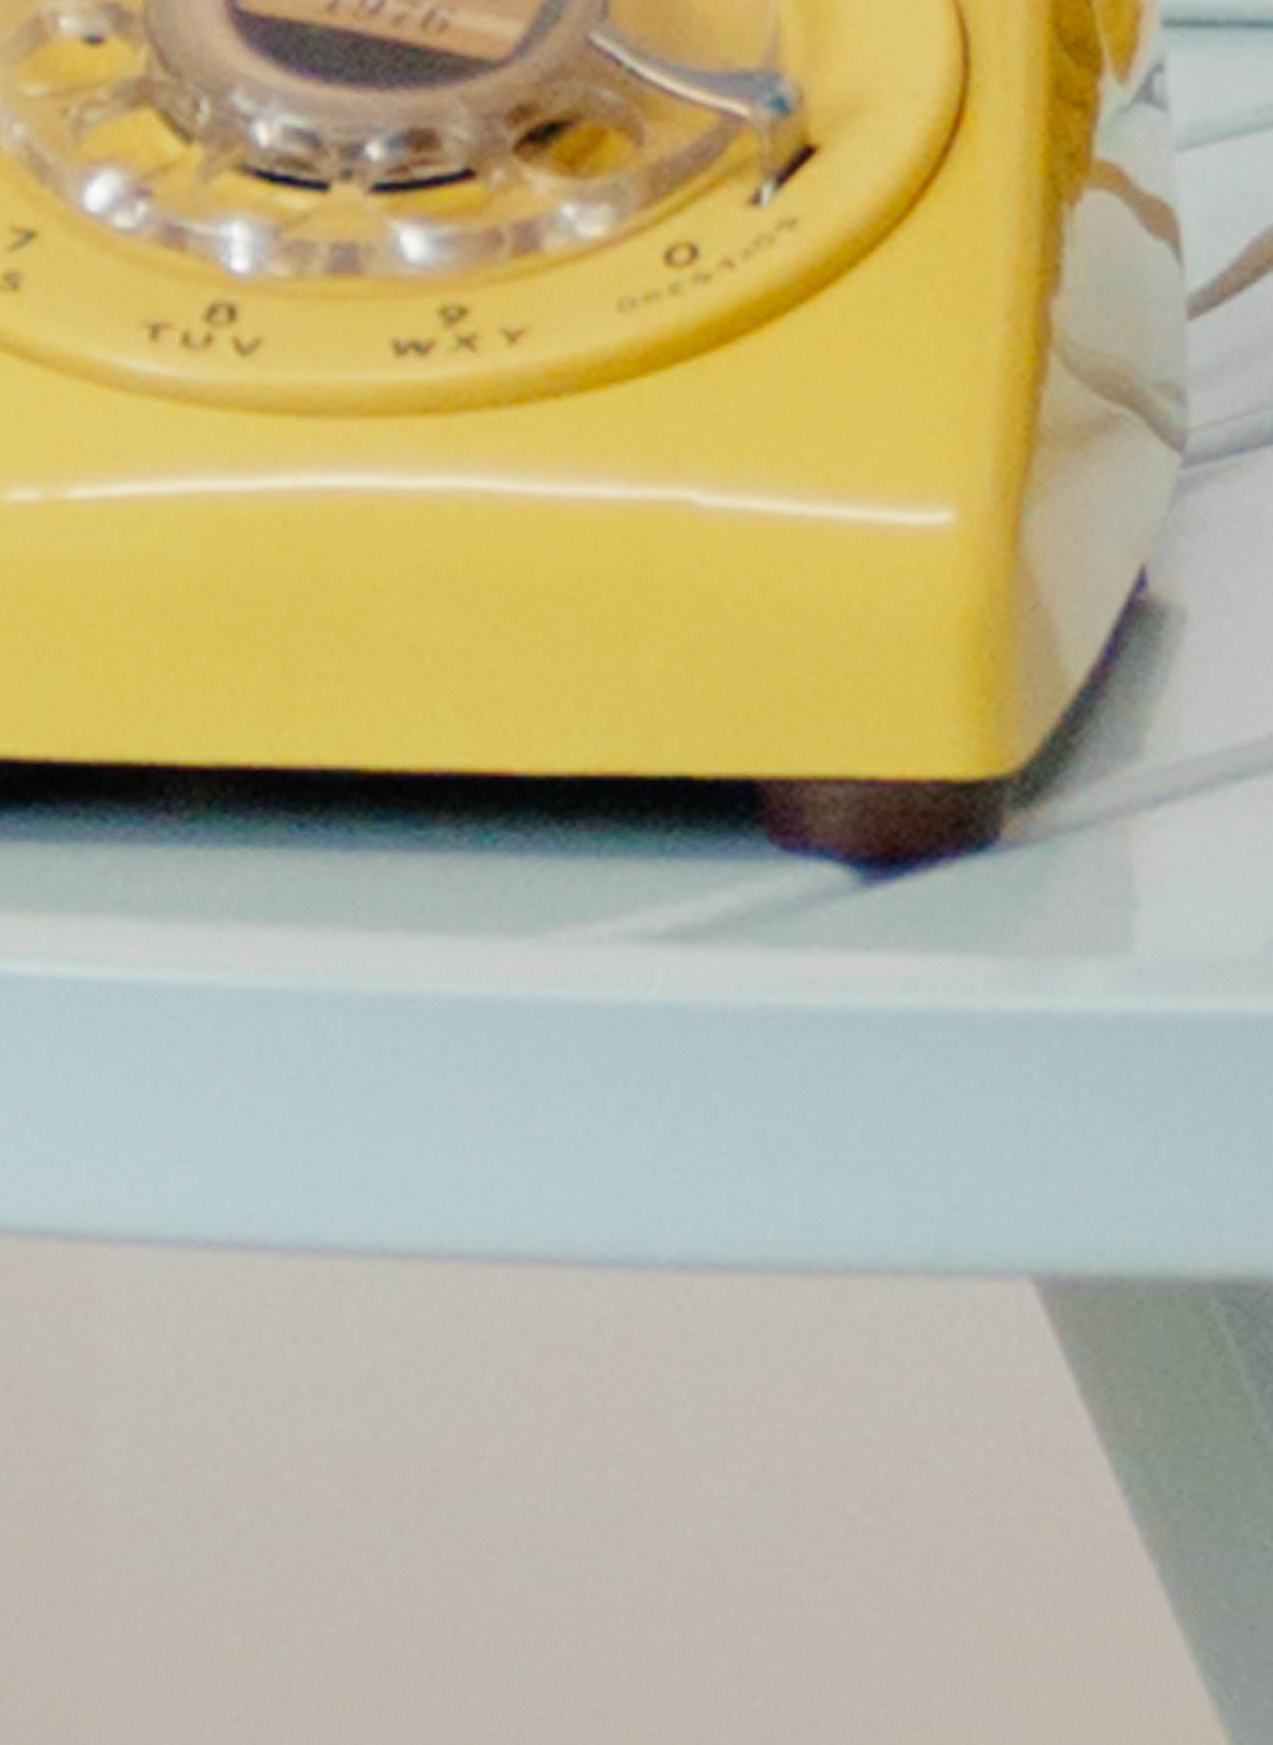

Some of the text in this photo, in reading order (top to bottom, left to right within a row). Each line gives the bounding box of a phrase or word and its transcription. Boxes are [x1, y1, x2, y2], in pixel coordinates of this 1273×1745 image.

[9, 225, 38, 251] 7
[141, 321, 263, 357] TUV
[392, 326, 528, 358] WXY
